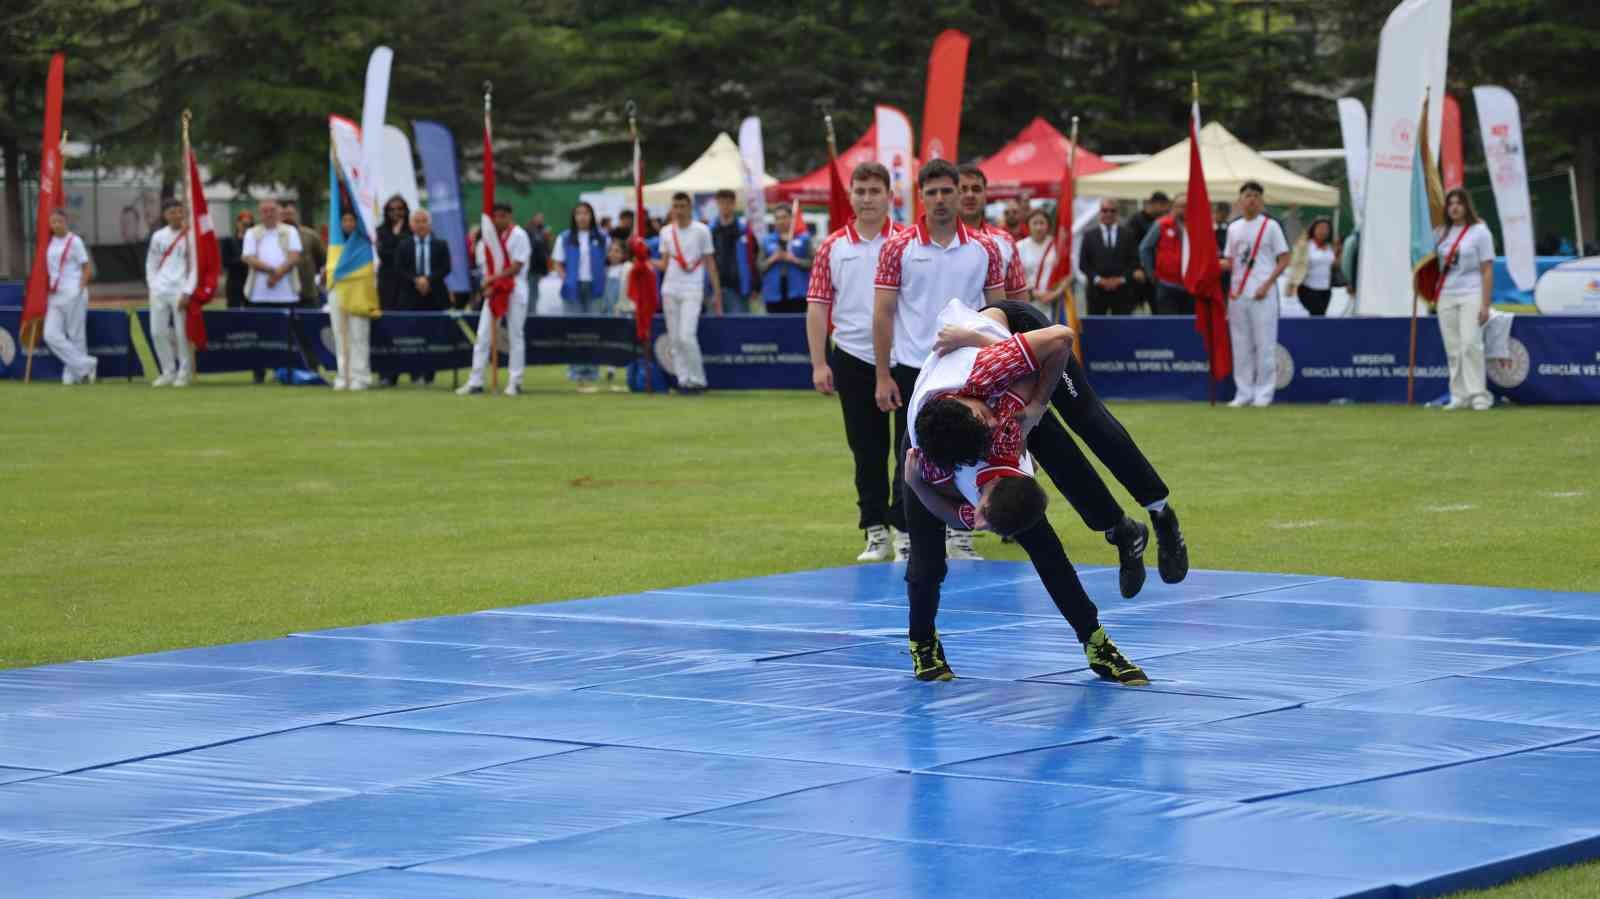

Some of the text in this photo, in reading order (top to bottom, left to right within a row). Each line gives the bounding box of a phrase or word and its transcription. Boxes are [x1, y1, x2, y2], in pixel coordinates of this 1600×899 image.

[1341, 367, 1353, 377] VE
[1355, 367, 1380, 377] SPOR
[1392, 366, 1450, 377] MÜÜRLÜĞÜ
